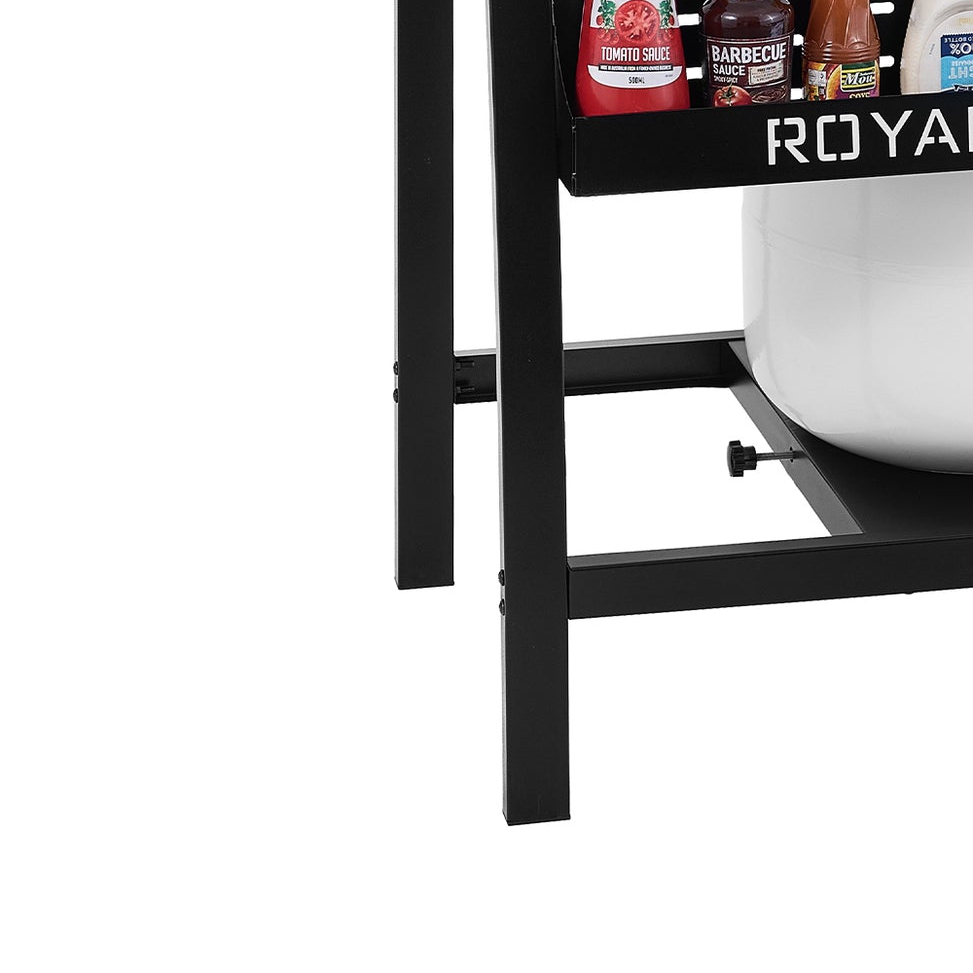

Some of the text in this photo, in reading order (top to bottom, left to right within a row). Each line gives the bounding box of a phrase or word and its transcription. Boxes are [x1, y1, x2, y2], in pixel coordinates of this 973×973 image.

[601, 47, 671, 62] TOMATO SAUCE
[711, 42, 786, 63] BARBECUE
[712, 63, 745, 76] SAUCE
